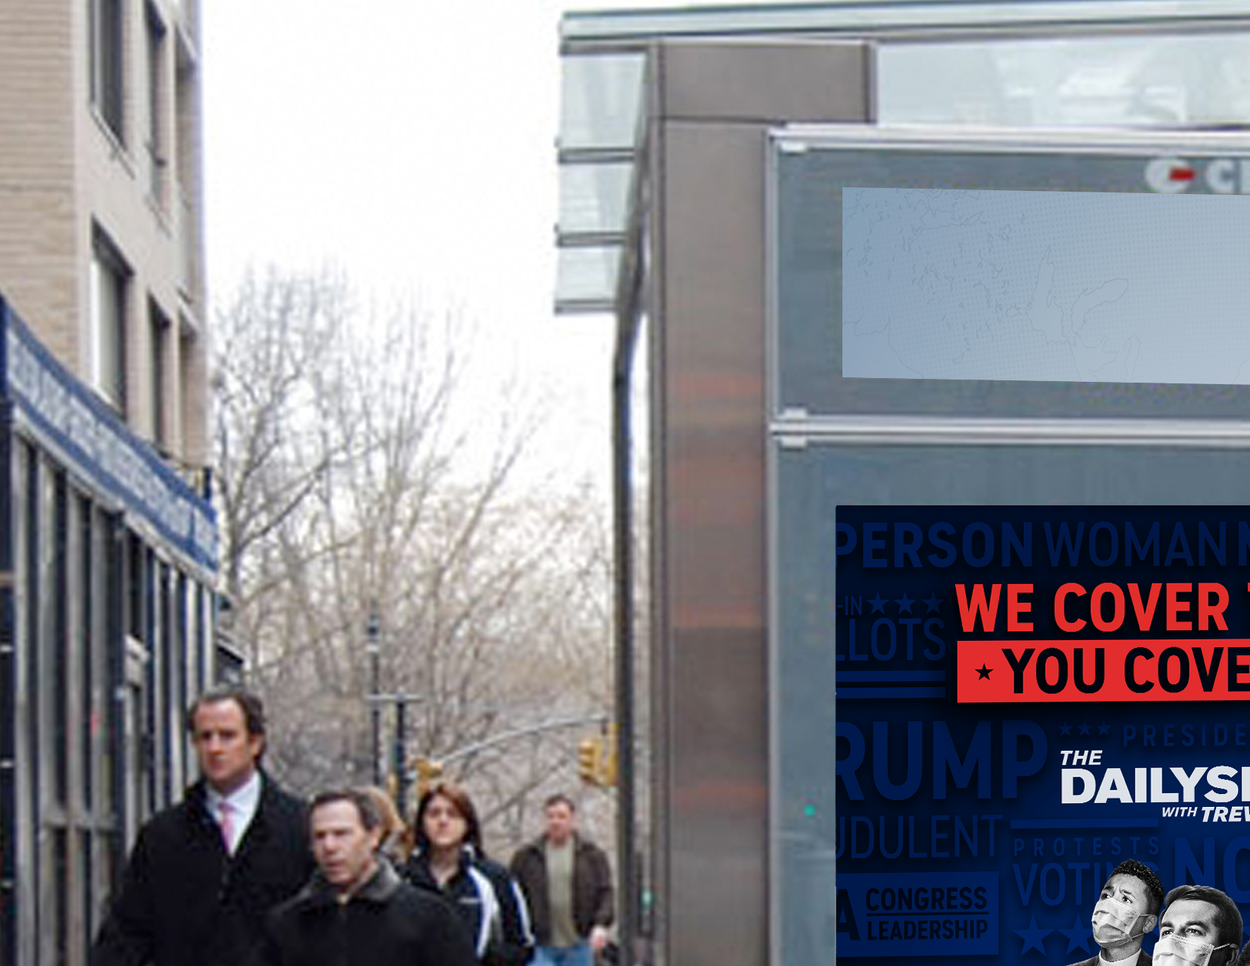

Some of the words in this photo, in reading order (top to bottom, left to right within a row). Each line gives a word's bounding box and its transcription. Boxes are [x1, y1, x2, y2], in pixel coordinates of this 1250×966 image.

[836, 521, 1033, 568] PERSON
[1043, 520, 1227, 567] WOMAN
[955, 584, 1033, 632] WE
[1055, 583, 1229, 632] COVER
[836, 617, 946, 661] LOTS
[1002, 648, 1104, 694] YOU
[1061, 750, 1102, 765] THE
[1163, 807, 1198, 817] WITH
[1013, 836, 1160, 857] PROTESTS
[865, 886, 988, 911] CONGRESS
[867, 919, 989, 940] LEADERSHIP
